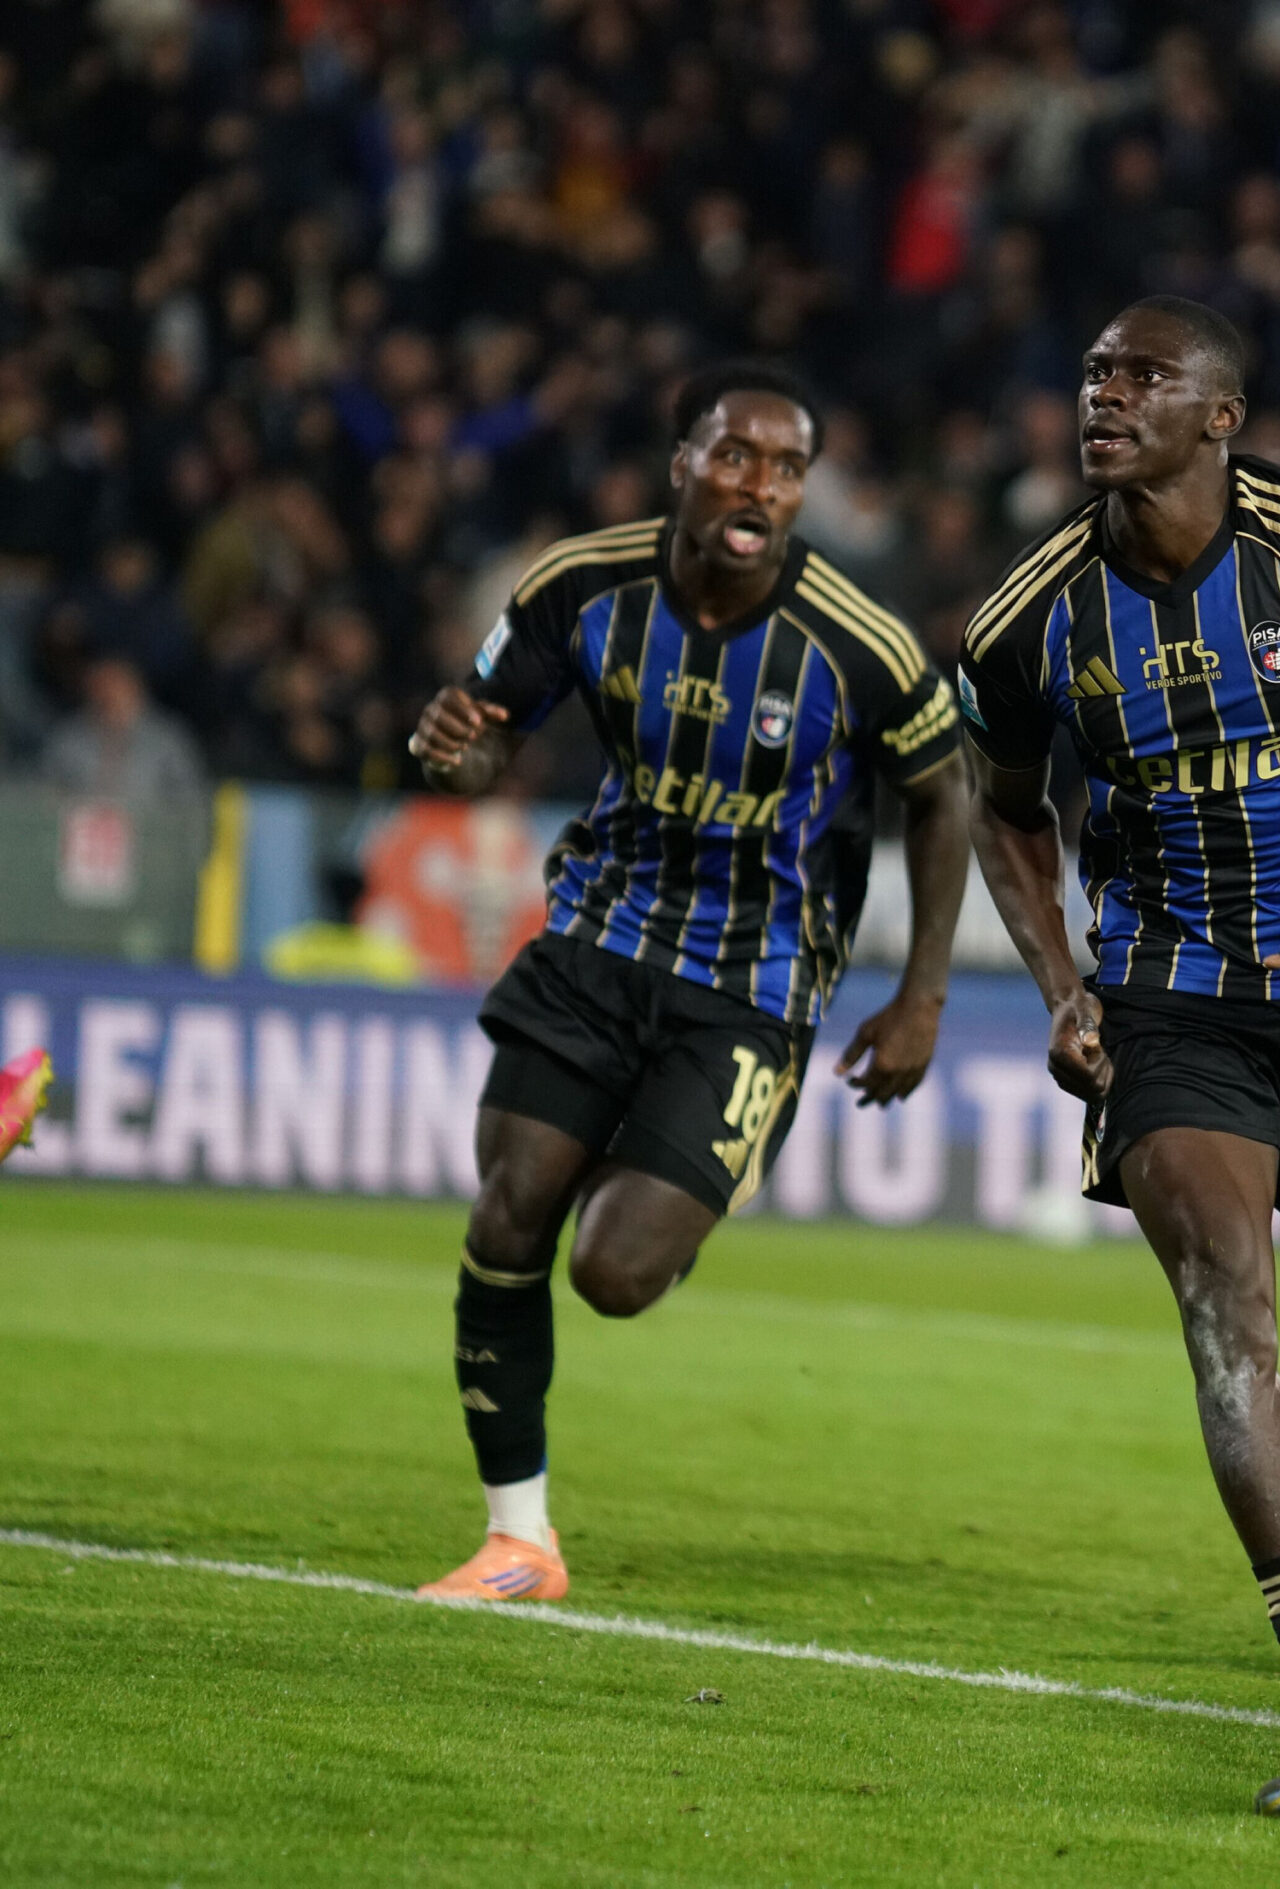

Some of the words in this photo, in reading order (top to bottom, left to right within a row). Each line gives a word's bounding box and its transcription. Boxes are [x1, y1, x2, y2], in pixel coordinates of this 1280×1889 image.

[1145, 677, 1176, 690] VERDE
[1177, 670, 1223, 686] SPORTIVO
[620, 750, 788, 828] etilar
[0, 992, 494, 1202] LEANIN
[723, 1045, 776, 1145] 18
